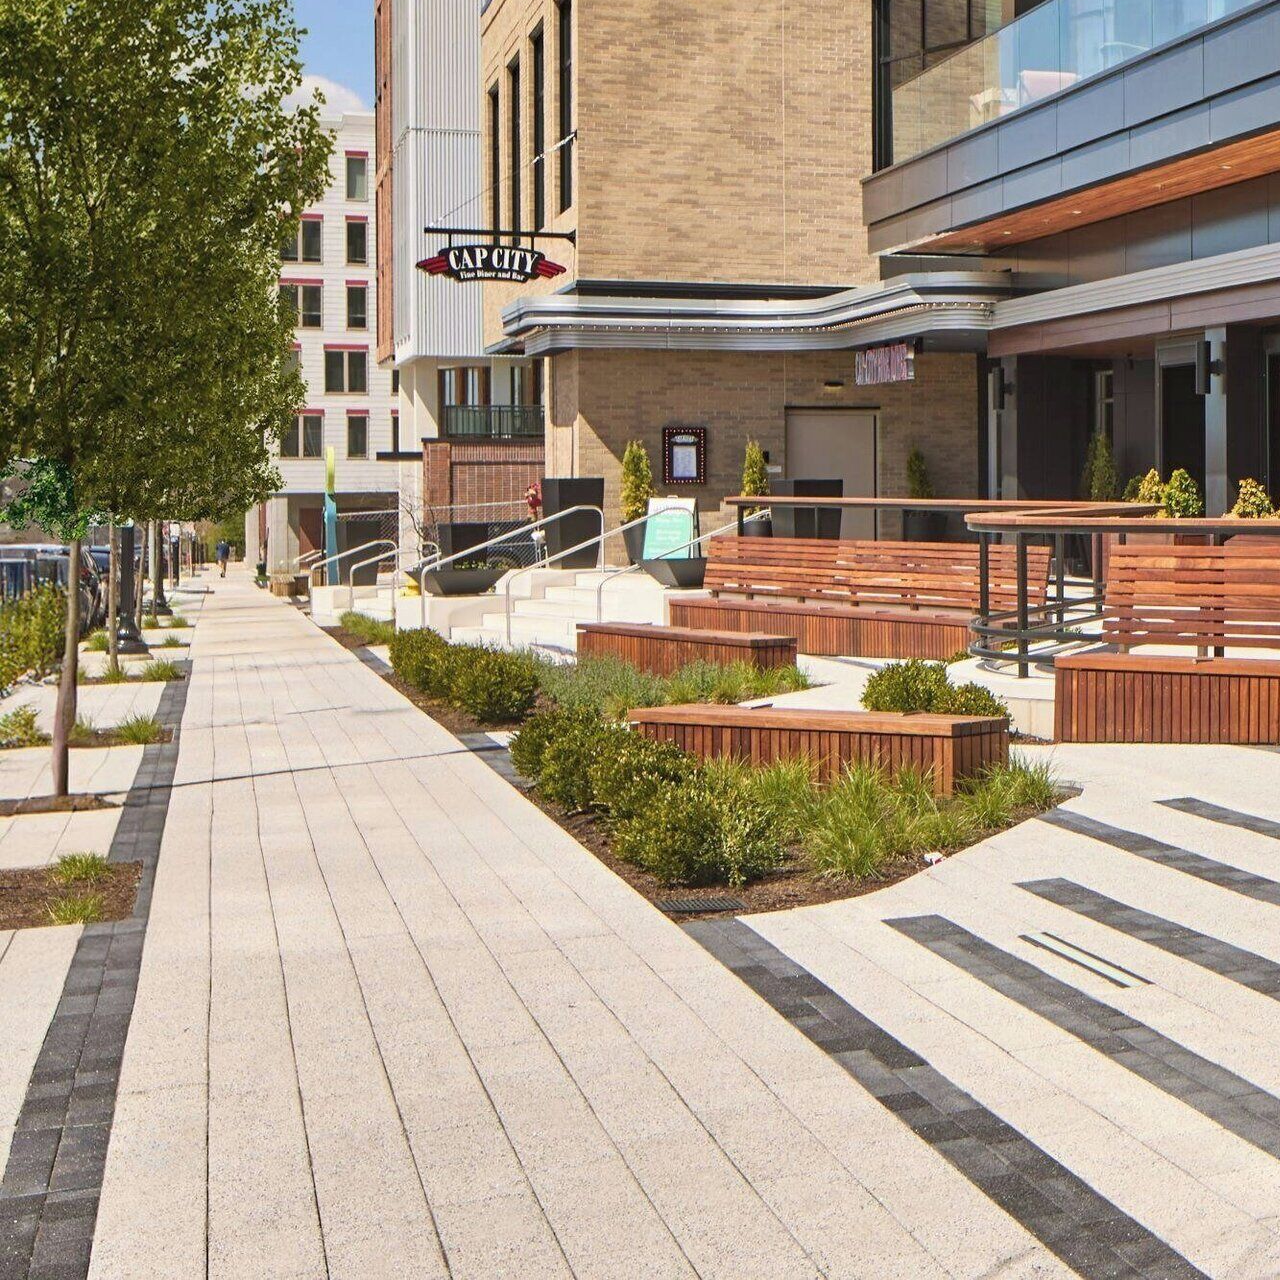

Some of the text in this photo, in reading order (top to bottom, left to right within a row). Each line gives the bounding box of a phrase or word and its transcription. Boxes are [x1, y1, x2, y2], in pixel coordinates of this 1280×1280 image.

[448, 247, 539, 274] CAP CITY
[460, 270, 525, 281] Fine Diner and Bar
